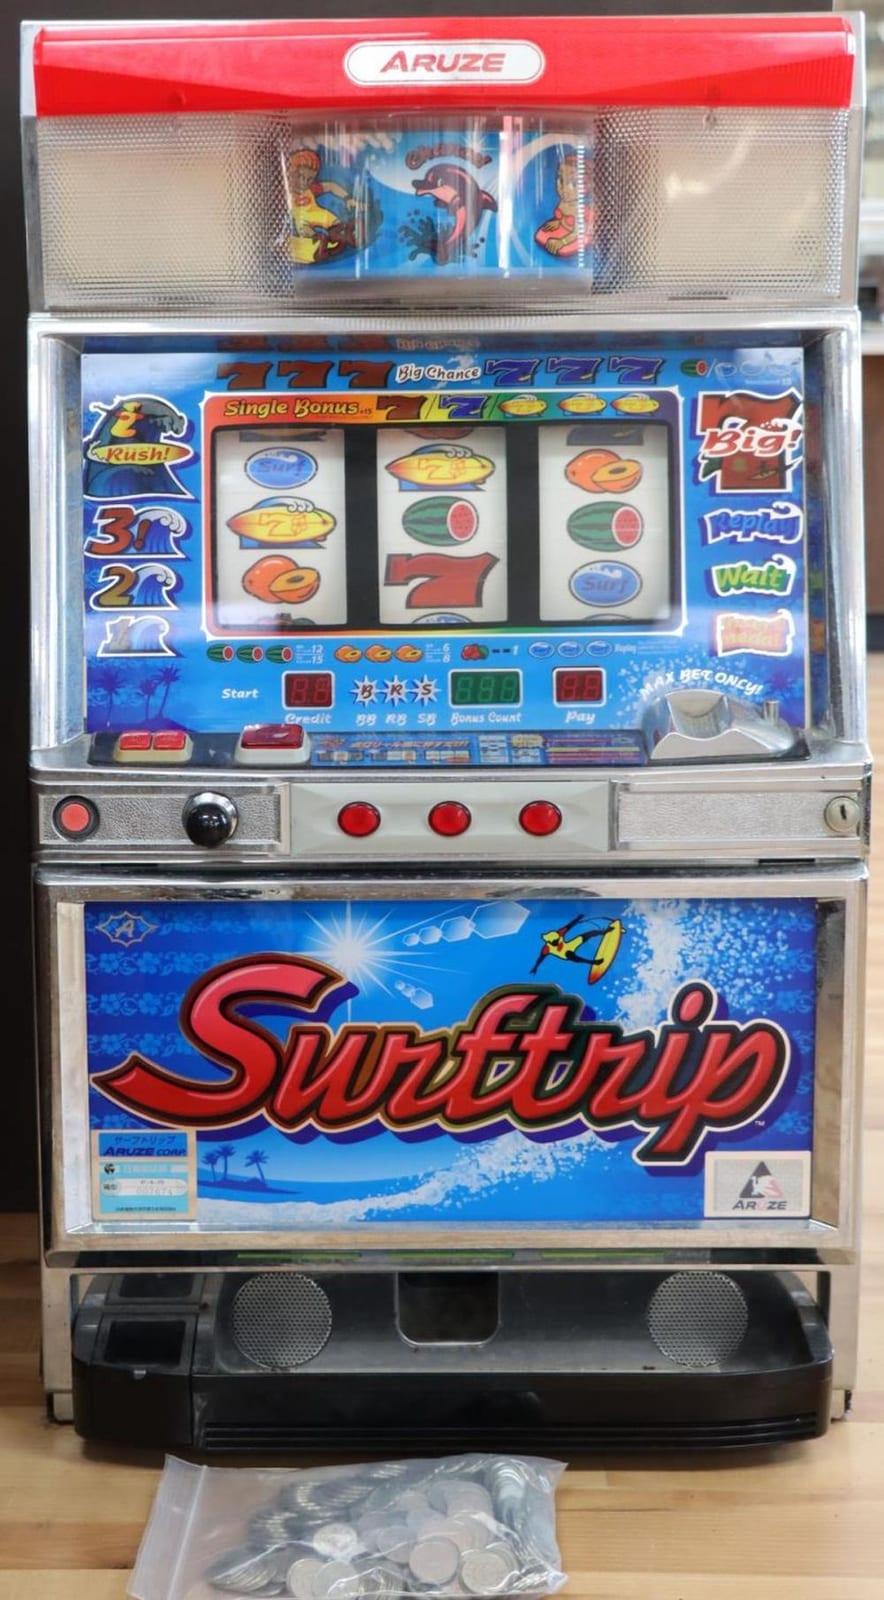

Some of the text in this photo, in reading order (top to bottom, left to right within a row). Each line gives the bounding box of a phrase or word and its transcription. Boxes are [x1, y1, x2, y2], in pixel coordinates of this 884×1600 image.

[380, 51, 507, 74] ARUZE
[397, 364, 421, 382] Big
[425, 365, 481, 382] Chance
[225, 400, 288, 418] Single
[295, 399, 358, 417] Bonus
[703, 428, 802, 456] Big!
[105, 446, 171, 462] Rush!
[257, 460, 305, 476] Surf
[709, 512, 802, 543] Replay
[384, 552, 500, 609] 7
[581, 576, 629, 594] Surf
[715, 563, 788, 591] Wait
[98, 565, 137, 606] 2
[360, 684, 432, 699] B R S
[639, 668, 764, 699] MAX BET ONLY!
[221, 688, 260, 699] Start
[285, 714, 332, 725] Credit
[356, 714, 378, 726] BB
[385, 713, 408, 725] RB
[417, 713, 437, 724] SB
[451, 712, 522, 726] Bonus Count
[566, 711, 596, 724] Pay
[92, 953, 791, 1166] Surftrip
[103, 1146, 155, 1157] ARUZE
[732, 1200, 788, 1211] ARUZE
